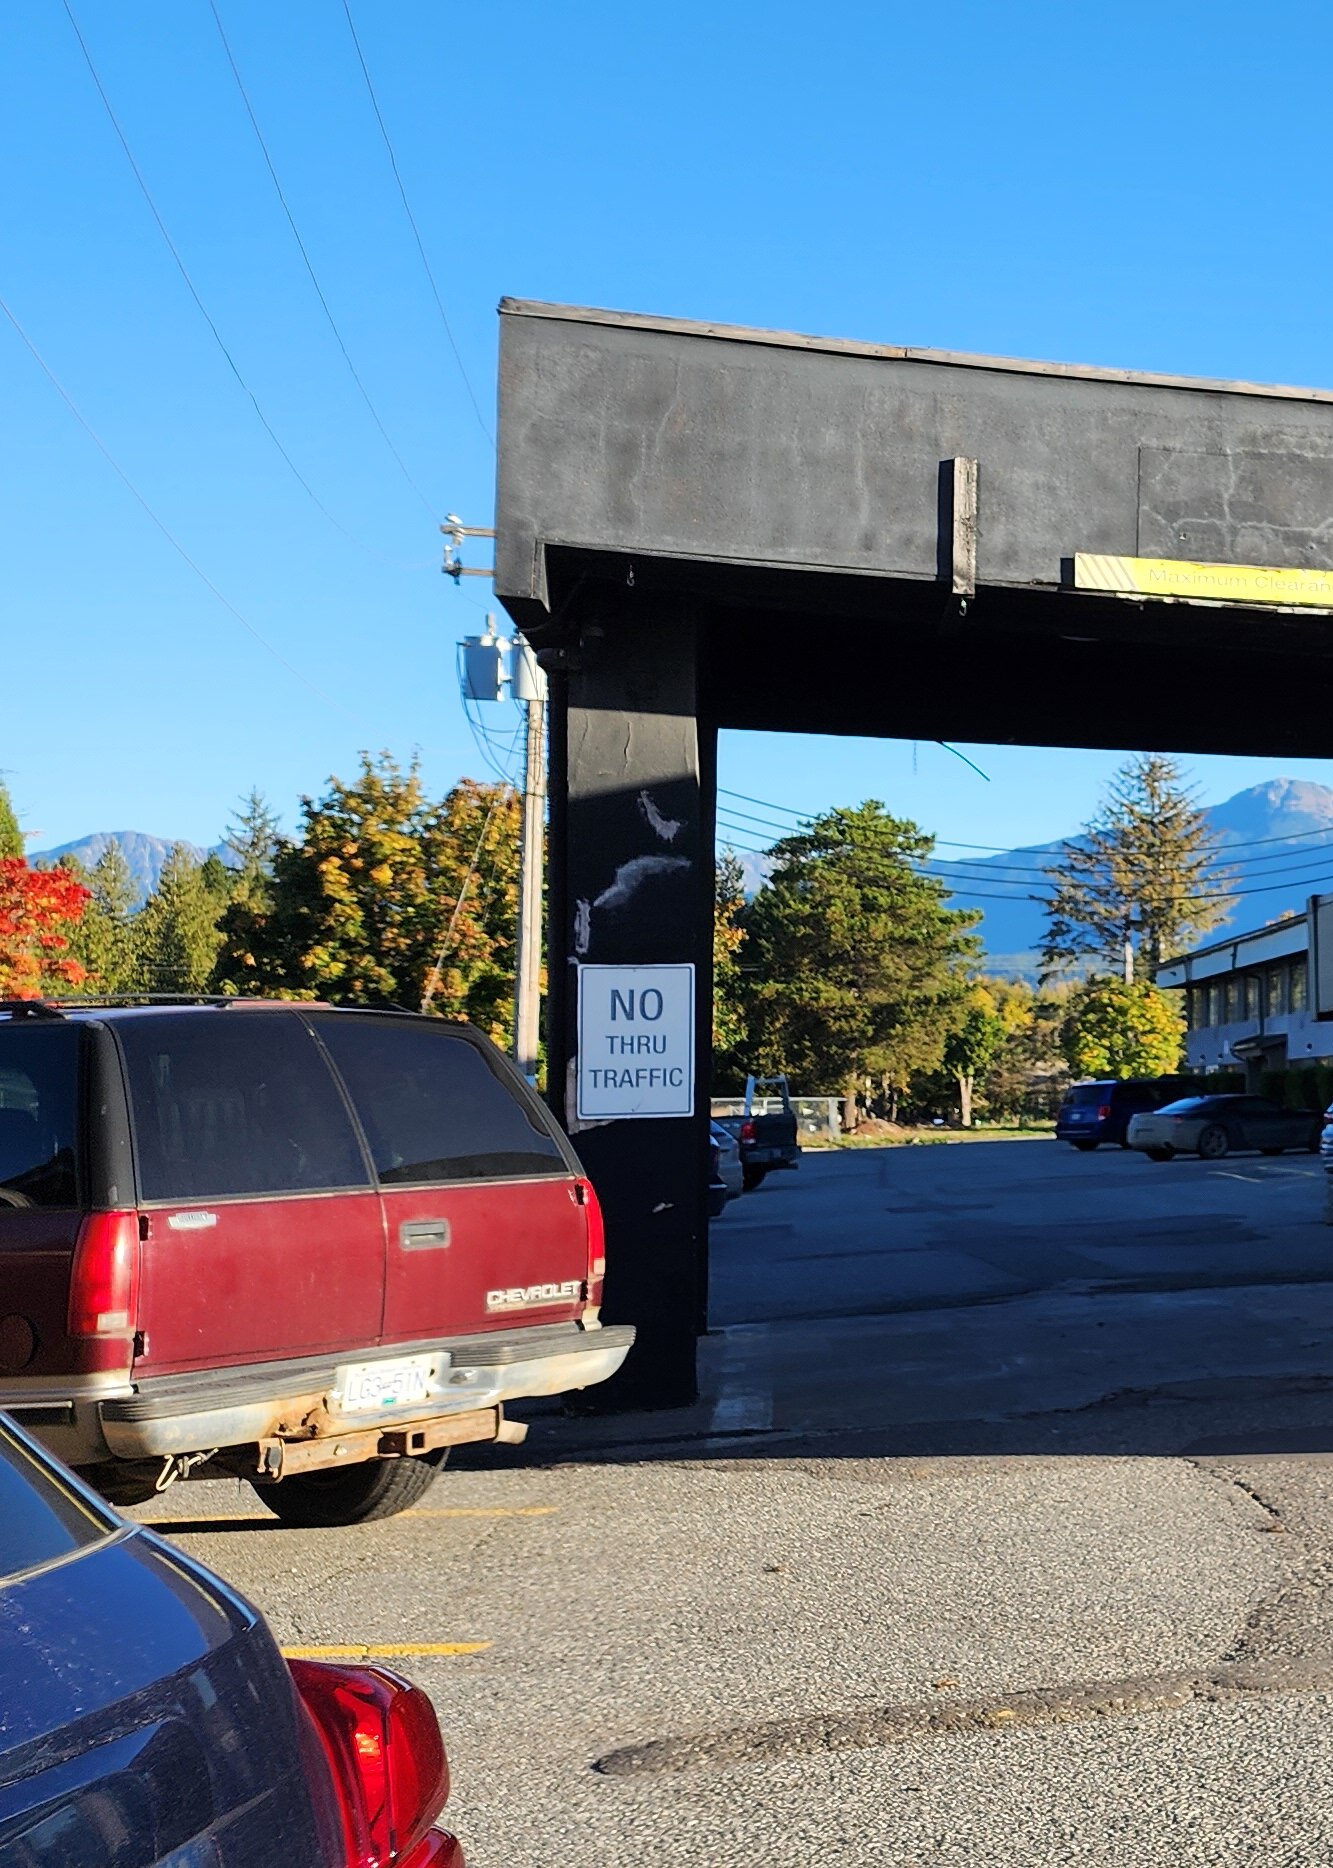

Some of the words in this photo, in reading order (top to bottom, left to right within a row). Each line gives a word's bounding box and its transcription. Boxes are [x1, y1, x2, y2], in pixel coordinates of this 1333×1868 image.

[1149, 568, 1247, 587] Maximum
[610, 988, 664, 1021] NO
[605, 1034, 667, 1055] THRU
[588, 1067, 683, 1088] TRAFFIC
[486, 1281, 582, 1304] CHEVROLET
